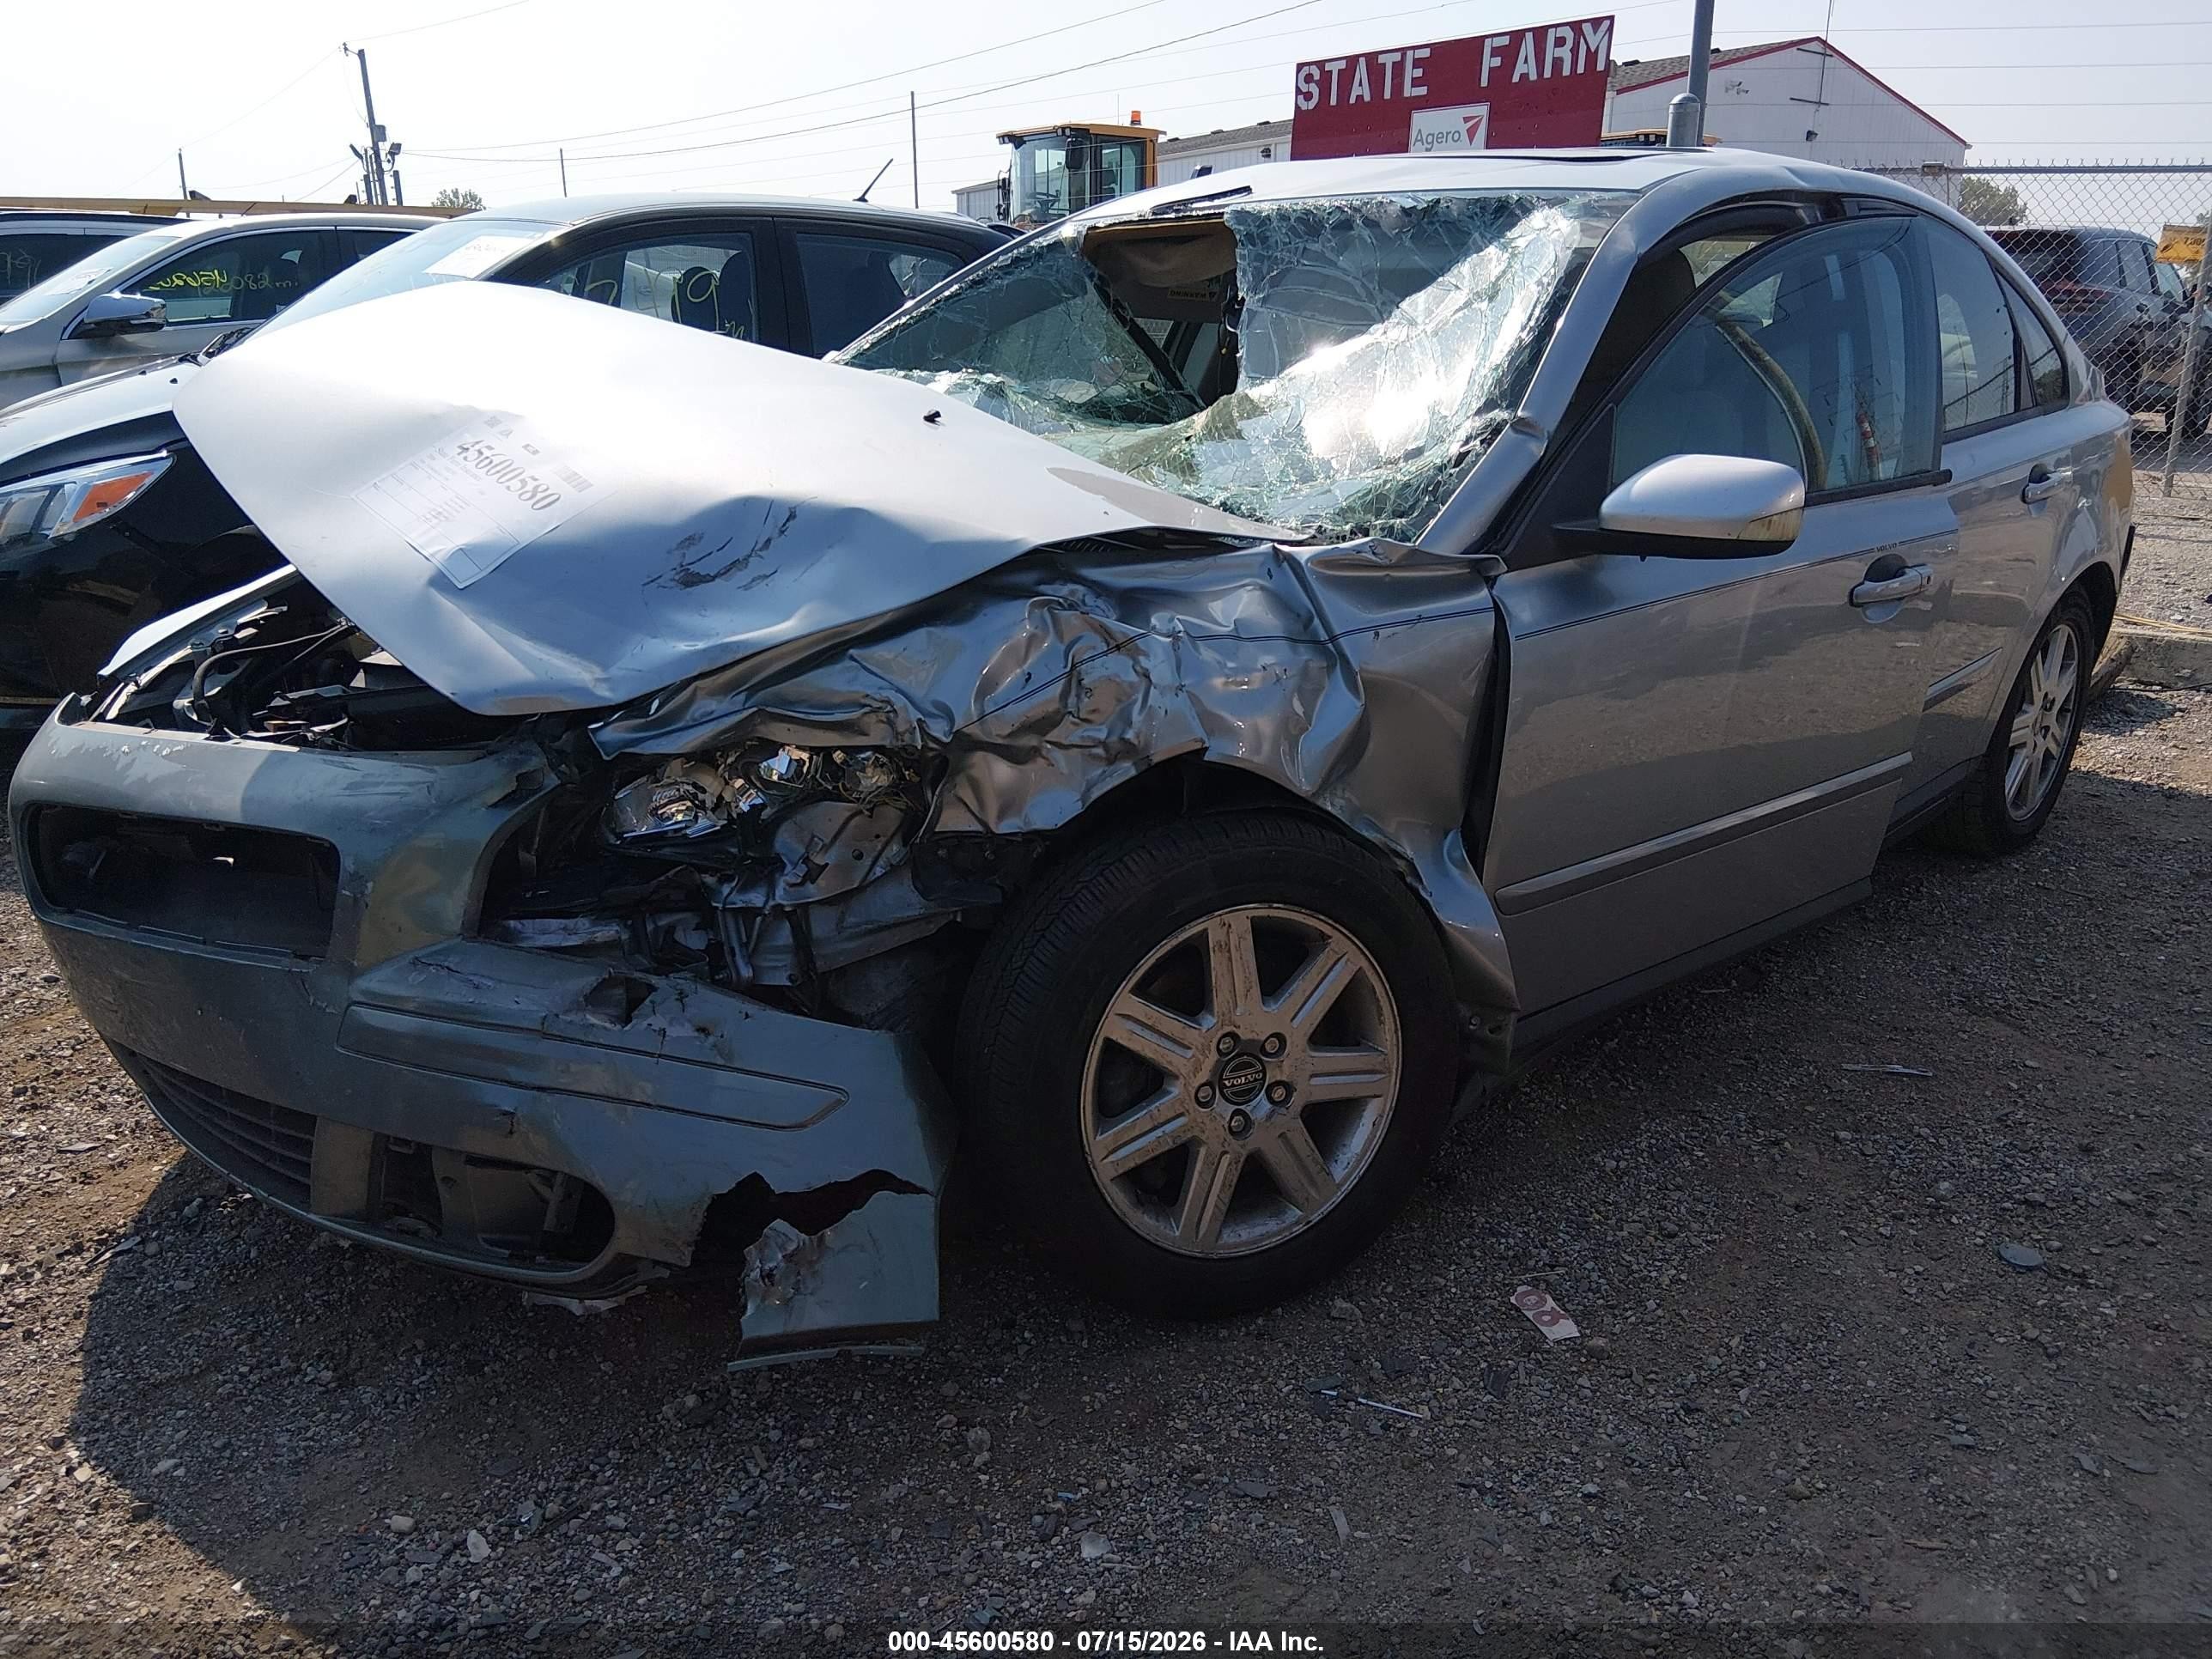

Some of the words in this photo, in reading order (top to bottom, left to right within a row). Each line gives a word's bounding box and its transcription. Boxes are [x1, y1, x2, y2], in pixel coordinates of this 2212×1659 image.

[1297, 48, 1431, 110] STATE
[1480, 20, 1611, 87] FARM
[1413, 129, 1462, 153] Agero
[456, 440, 562, 511] 45600580
[1875, 542, 1898, 553] VOLVO
[1223, 1072, 1263, 1087] VOLVO
